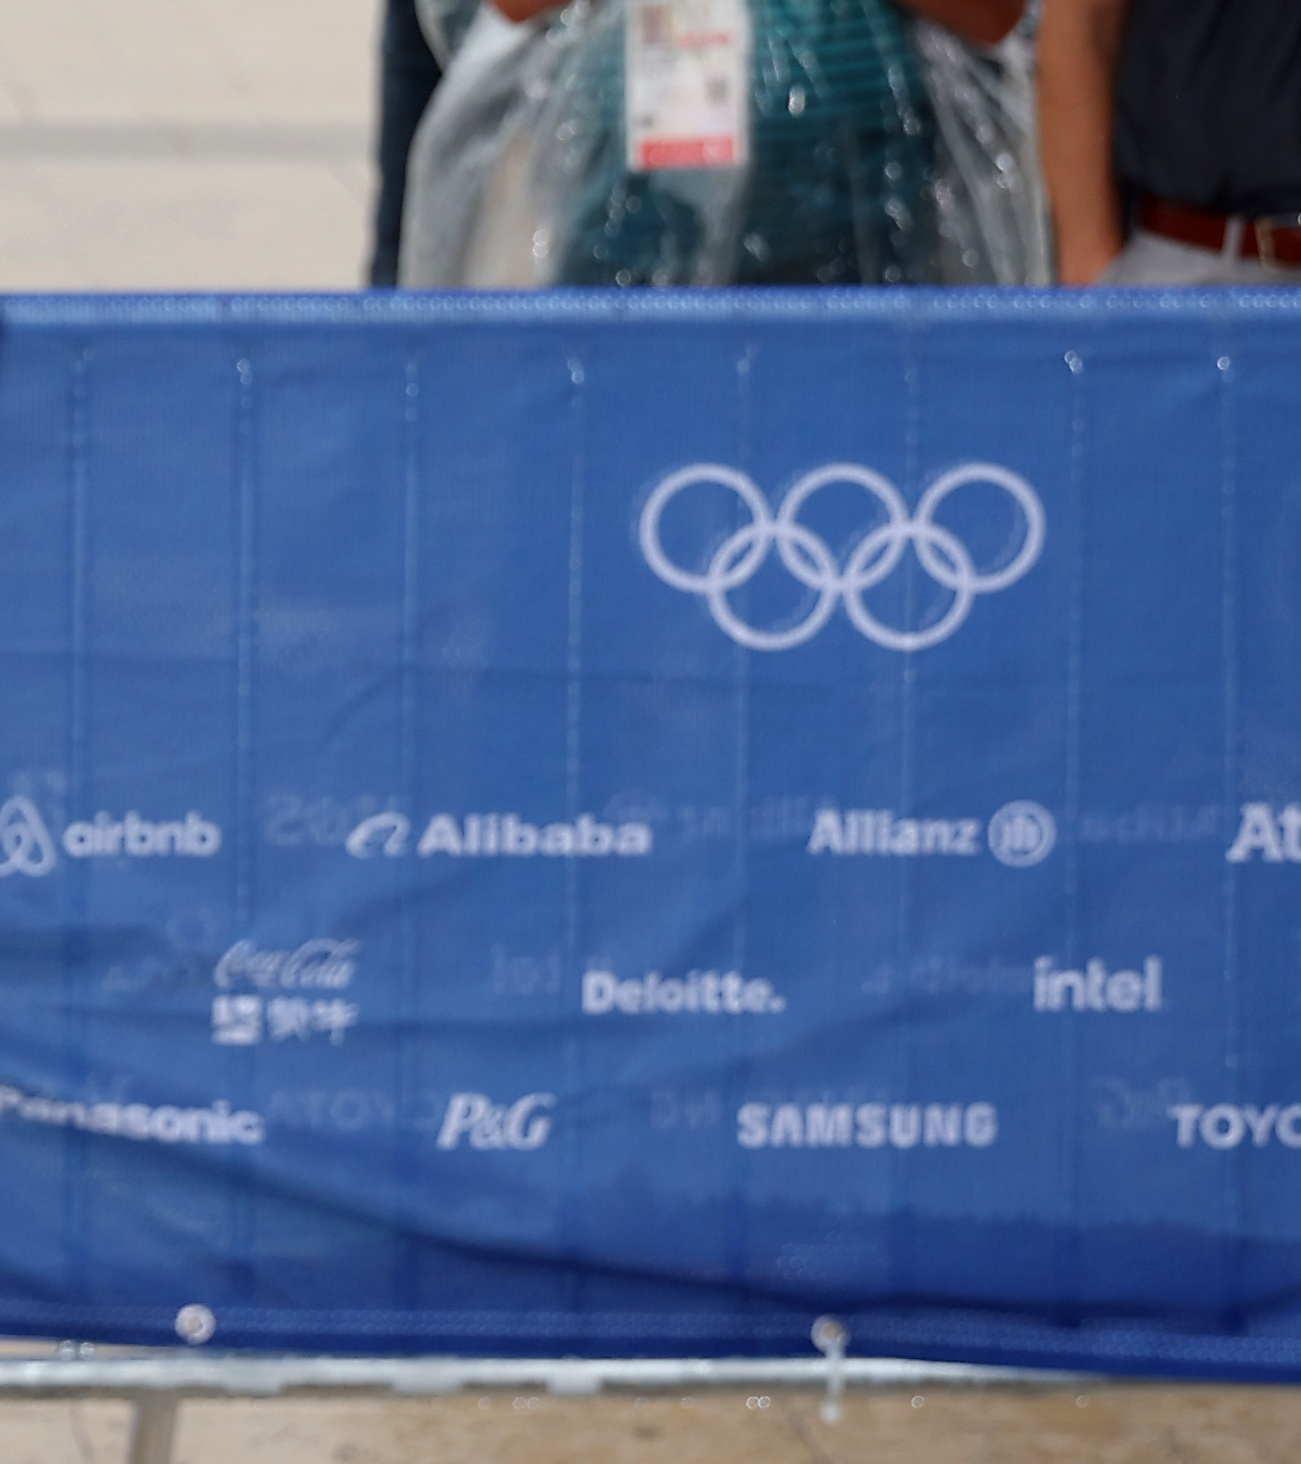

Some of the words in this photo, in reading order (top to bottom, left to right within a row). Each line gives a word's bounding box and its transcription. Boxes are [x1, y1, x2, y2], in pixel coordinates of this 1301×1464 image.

[62, 811, 221, 858] airbnb
[417, 812, 653, 857] Alibaba
[808, 807, 980, 857] Allianz
[581, 969, 786, 1015] Deloitte.
[1033, 955, 1162, 1012] intel
[437, 1092, 553, 1149] P&G
[736, 1102, 997, 1149] SAMSUNG
